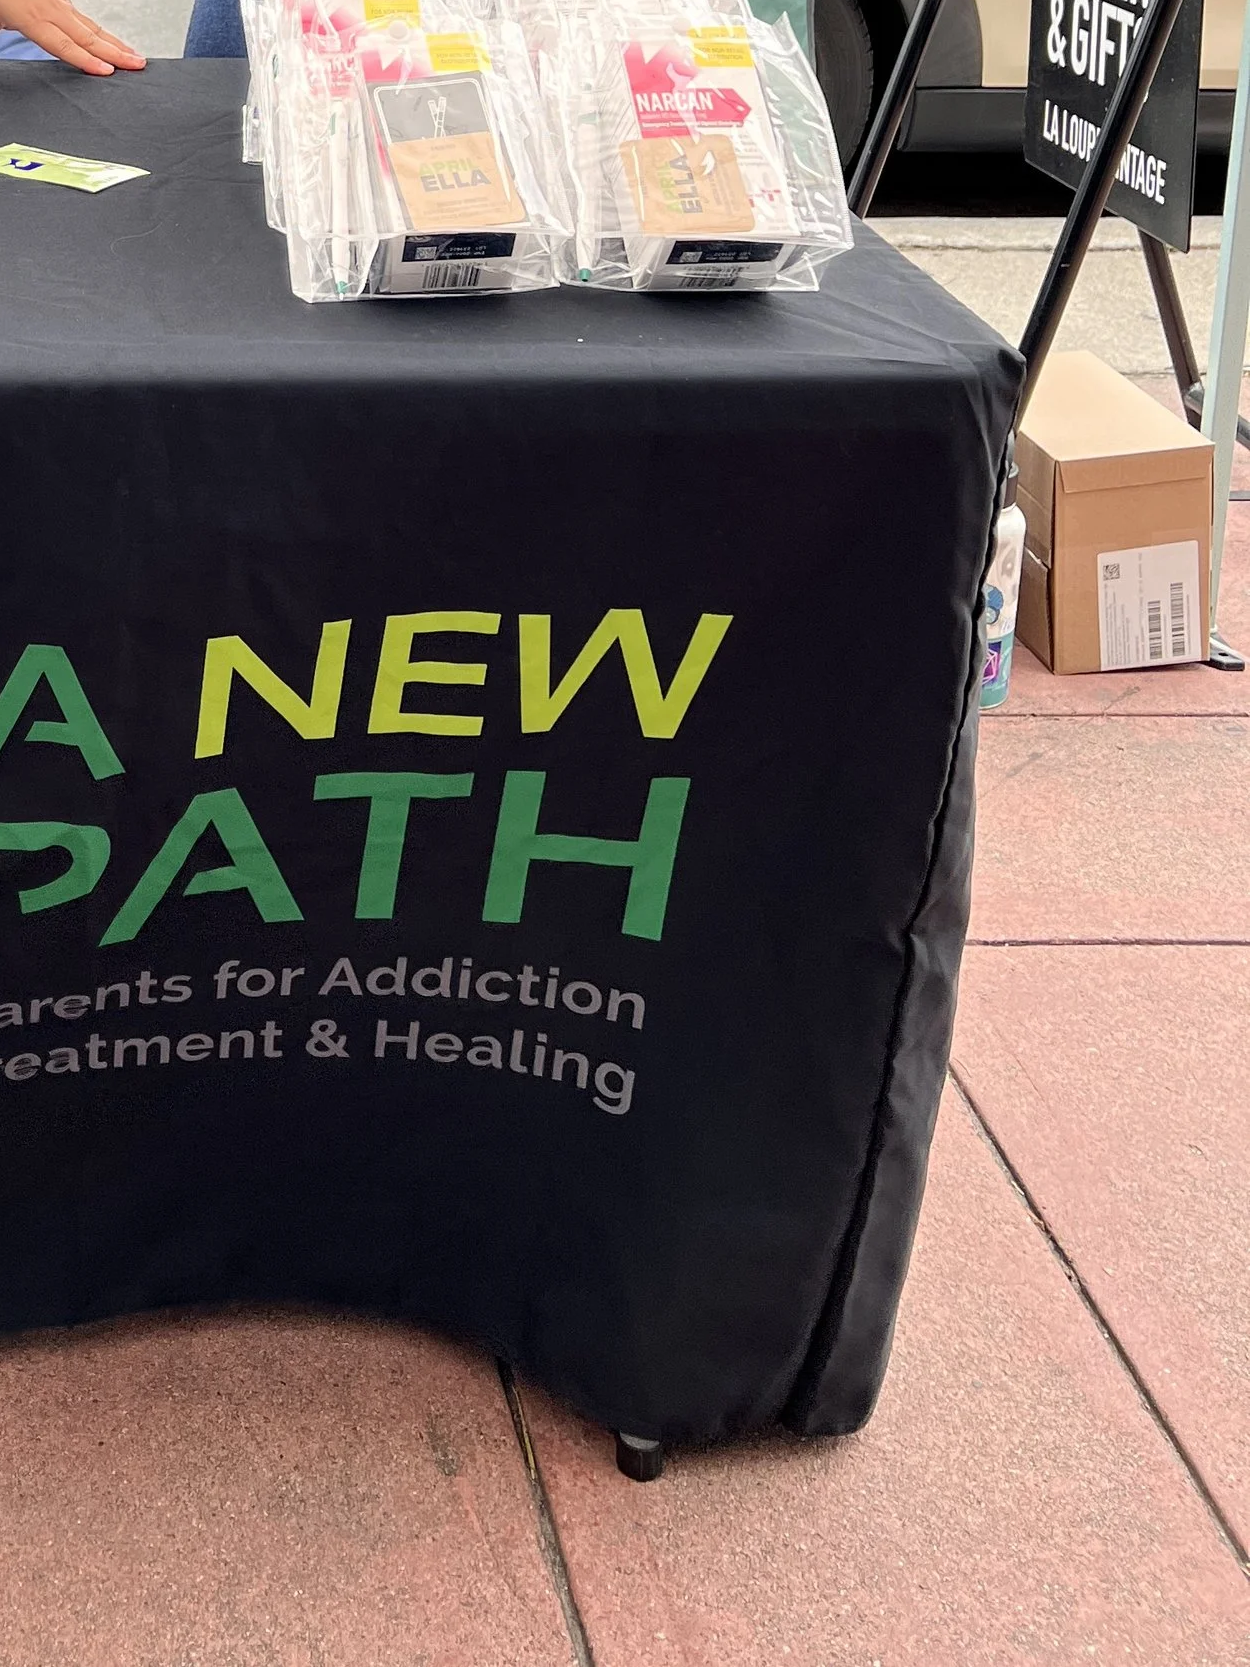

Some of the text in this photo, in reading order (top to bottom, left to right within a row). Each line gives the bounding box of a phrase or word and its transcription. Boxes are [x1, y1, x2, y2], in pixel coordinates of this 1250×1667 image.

[635, 92, 714, 113] NARCAN
[419, 157, 481, 176] APRIL
[420, 167, 491, 193] ELLA
[669, 154, 704, 214] ELLA
[1042, 99, 1167, 205] LA LOUP NTAGE
[195, 608, 734, 760] NEW
[213, 959, 304, 999] for
[318, 957, 647, 1031] Addiction
[307, 1018, 350, 1059] &
[374, 1019, 637, 1115] Healing
